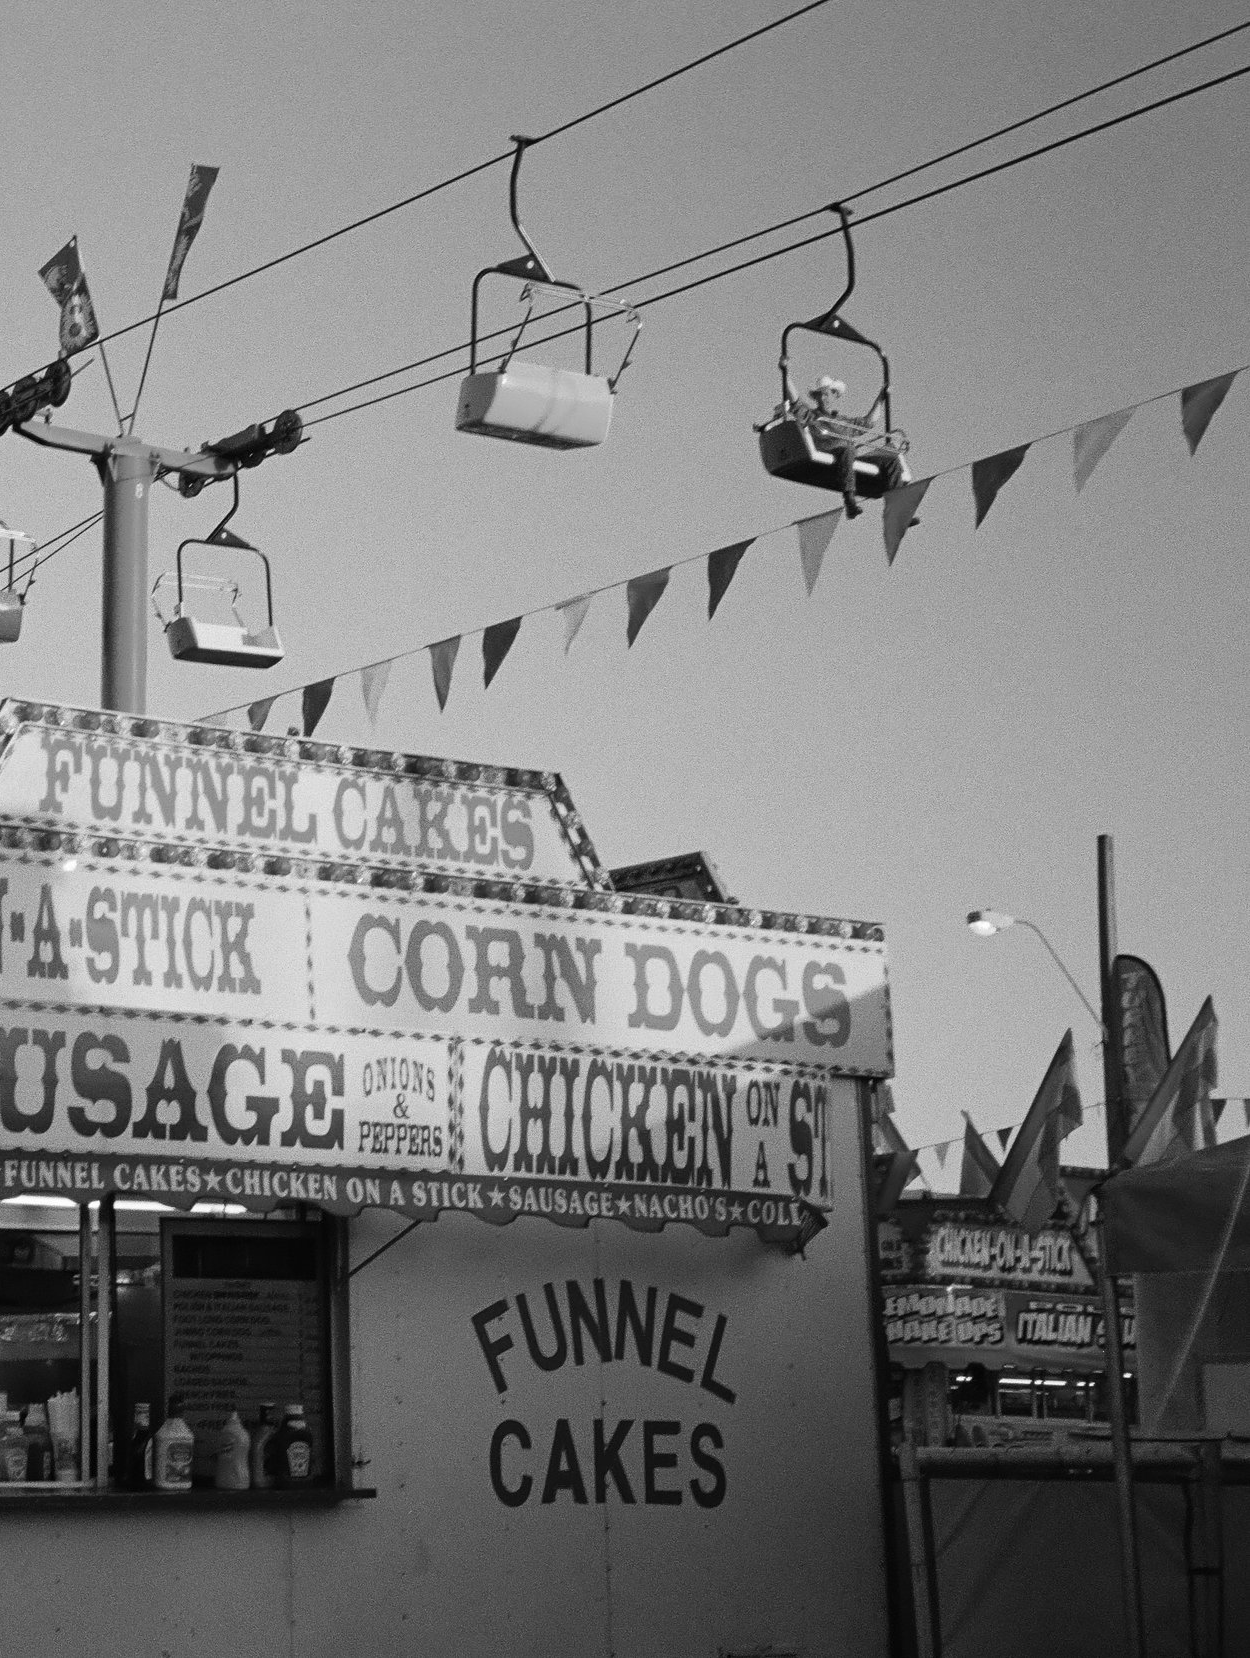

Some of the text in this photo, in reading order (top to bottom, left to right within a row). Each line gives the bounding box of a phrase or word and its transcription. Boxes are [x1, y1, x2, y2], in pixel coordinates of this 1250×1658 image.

[39, 733, 535, 871] FUNNEL CAKES
[347, 912, 851, 1048] CORN DOGS
[362, 1056, 436, 1102] ONIONS
[746, 1080, 781, 1127] ON
[392, 1092, 411, 1119] &
[478, 1046, 738, 1190] CHICKEN
[357, 1120, 443, 1157] PEPPERS
[751, 1140, 771, 1189] A
[3, 1158, 105, 1190] FUNNEL
[113, 1162, 201, 1193] CAKES
[225, 1168, 338, 1200] CHICKEN
[345, 1177, 381, 1204] ON
[389, 1179, 404, 1206] A
[412, 1180, 484, 1209] STICK
[508, 1184, 615, 1217] SAUSAGE
[634, 1192, 729, 1222] NACHO'S
[883, 1293, 1000, 1317] EMONADE
[1019, 1312, 1093, 1345] ITALIAN
[470, 1277, 738, 1405] FUNNEL
[489, 1418, 728, 1509] CAKES
